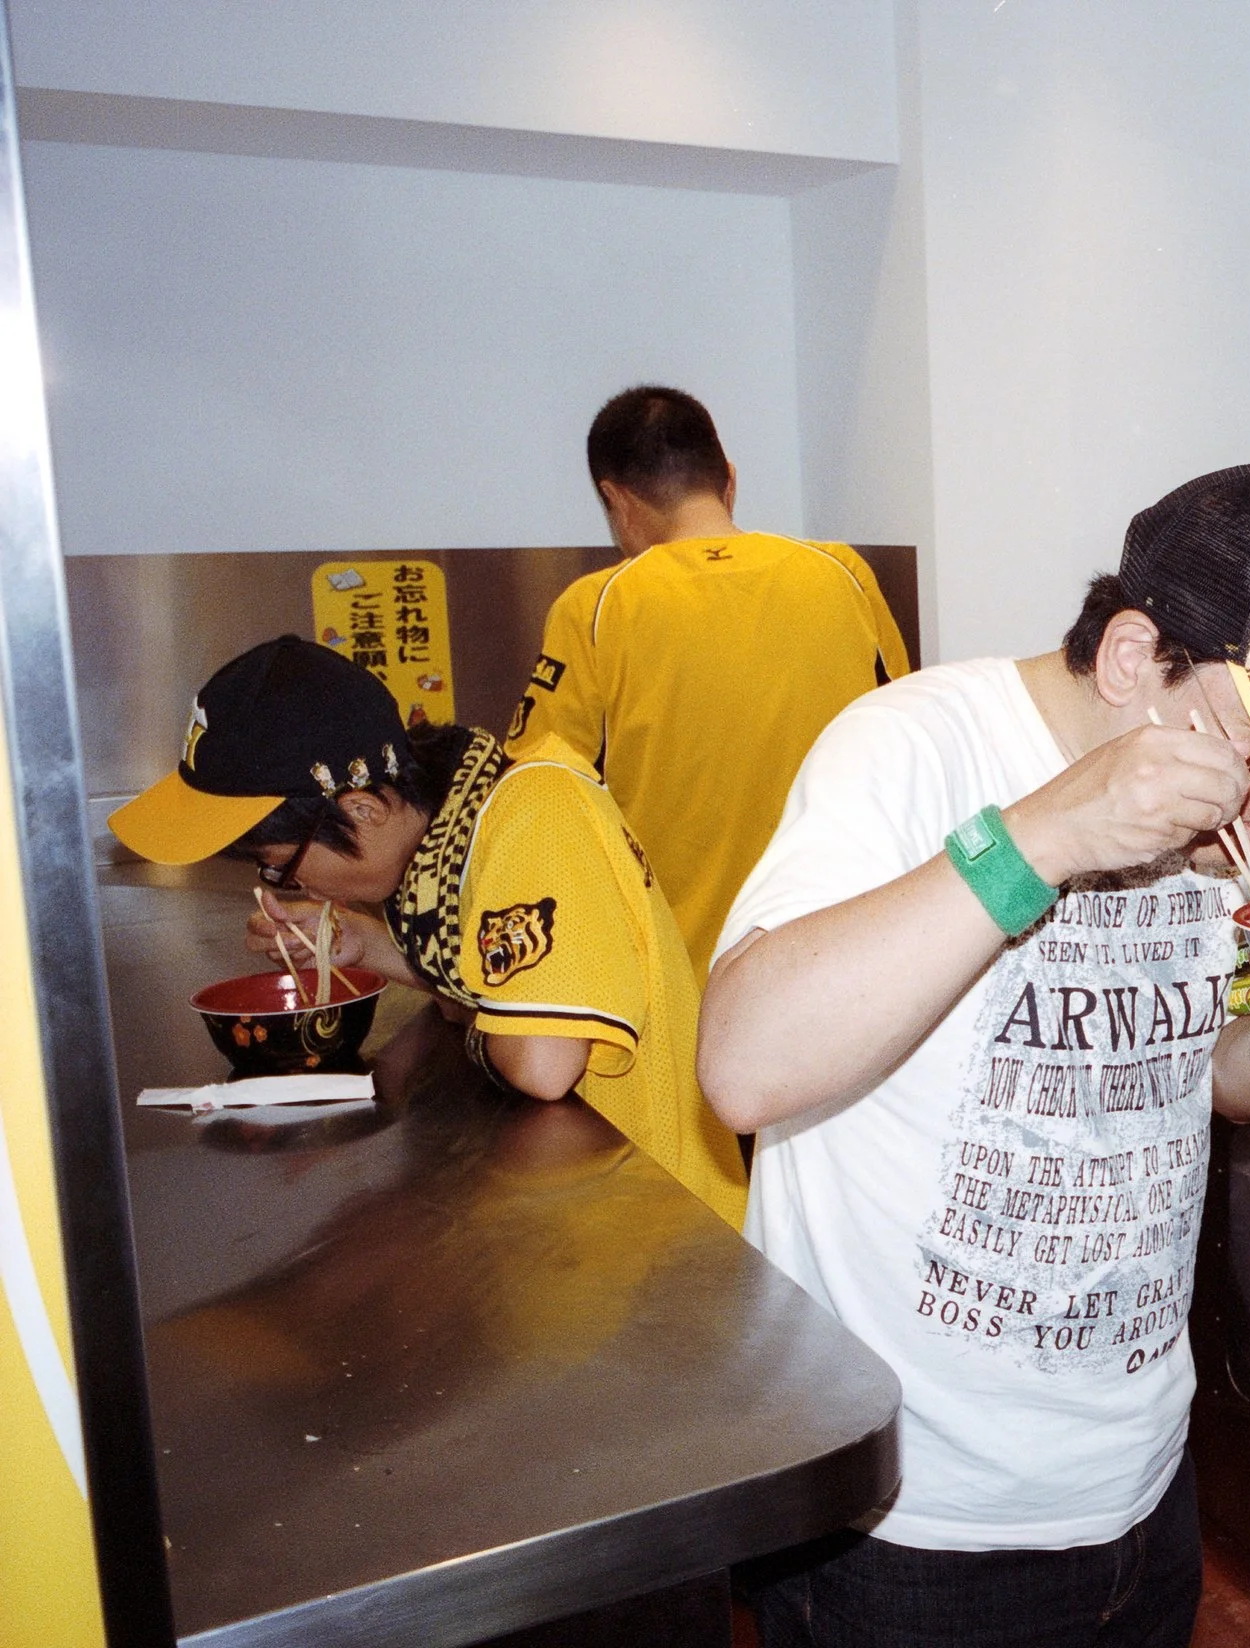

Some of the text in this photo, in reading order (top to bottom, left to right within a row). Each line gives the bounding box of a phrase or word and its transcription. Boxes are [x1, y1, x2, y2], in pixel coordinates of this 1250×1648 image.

[393, 564, 430, 664] お忘れ物に
[1137, 894, 1160, 927] OF
[1039, 940, 1089, 964] SEEN
[1124, 940, 1175, 964] LIVED
[980, 1056, 1024, 1112] NOW
[960, 1140, 1015, 1179] UPON
[1028, 1155, 1064, 1187] THE
[1073, 1150, 1135, 1187] ATTEMPT
[1143, 1144, 1159, 1177] TO
[952, 1172, 992, 1211] THE
[1001, 1187, 1139, 1226] METAPHYSICAL
[1148, 1179, 1173, 1215] ONE
[940, 1207, 1022, 1258] EASILY
[1034, 1234, 1072, 1265] GET
[1081, 1231, 1127, 1264] LOST
[924, 1259, 1038, 1315] NEVER
[1064, 1290, 1118, 1319] LET
[917, 1290, 1004, 1338] BOSS
[1034, 1325, 1096, 1351] YOU
